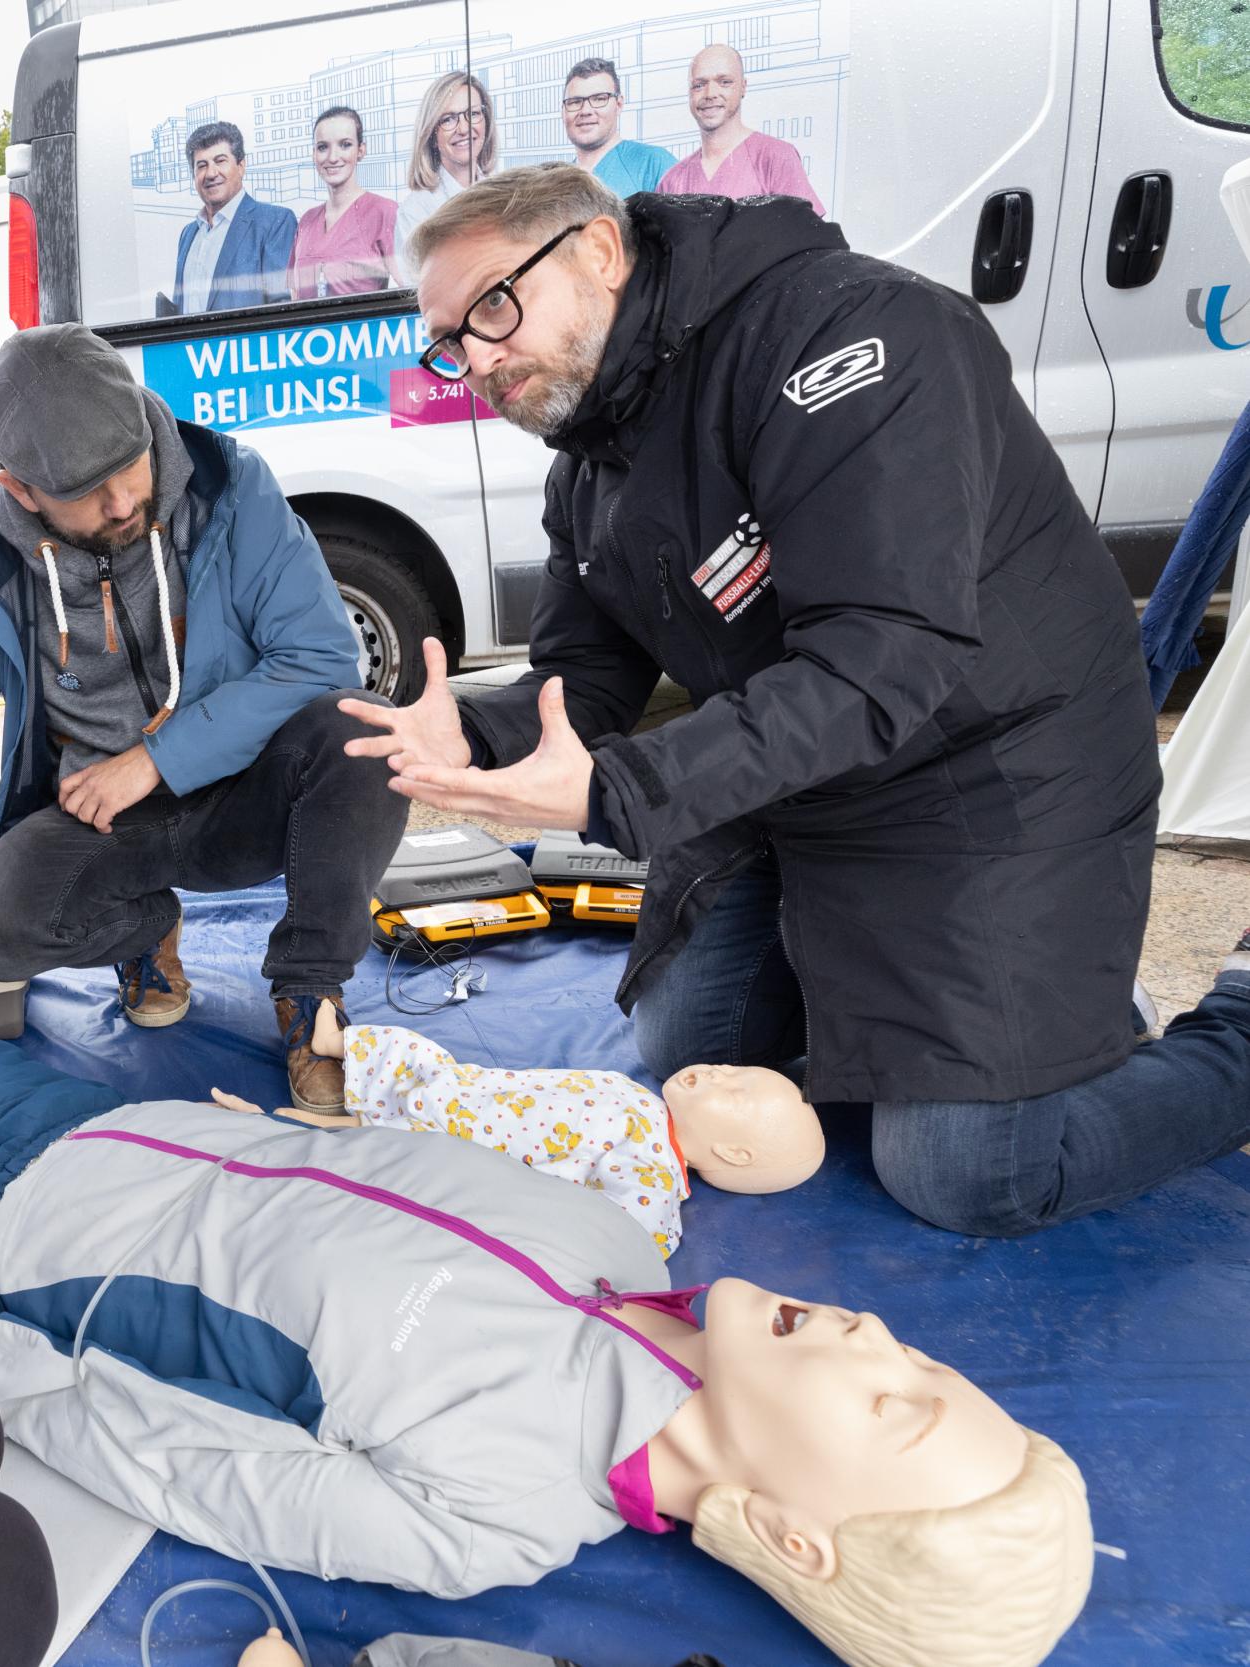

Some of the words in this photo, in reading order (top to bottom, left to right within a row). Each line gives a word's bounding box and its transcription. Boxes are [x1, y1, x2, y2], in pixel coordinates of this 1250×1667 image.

[186, 317, 430, 379] WILLKOMME
[193, 387, 248, 426] BEI
[265, 374, 361, 418] UNS!
[428, 383, 464, 401] 5.741
[705, 554, 747, 597] DEUTSCHER
[724, 586, 763, 623] Kompetenz
[567, 856, 649, 873] TRAINE
[412, 1266, 453, 1315] Resusci
[390, 1311, 421, 1352] Anne
